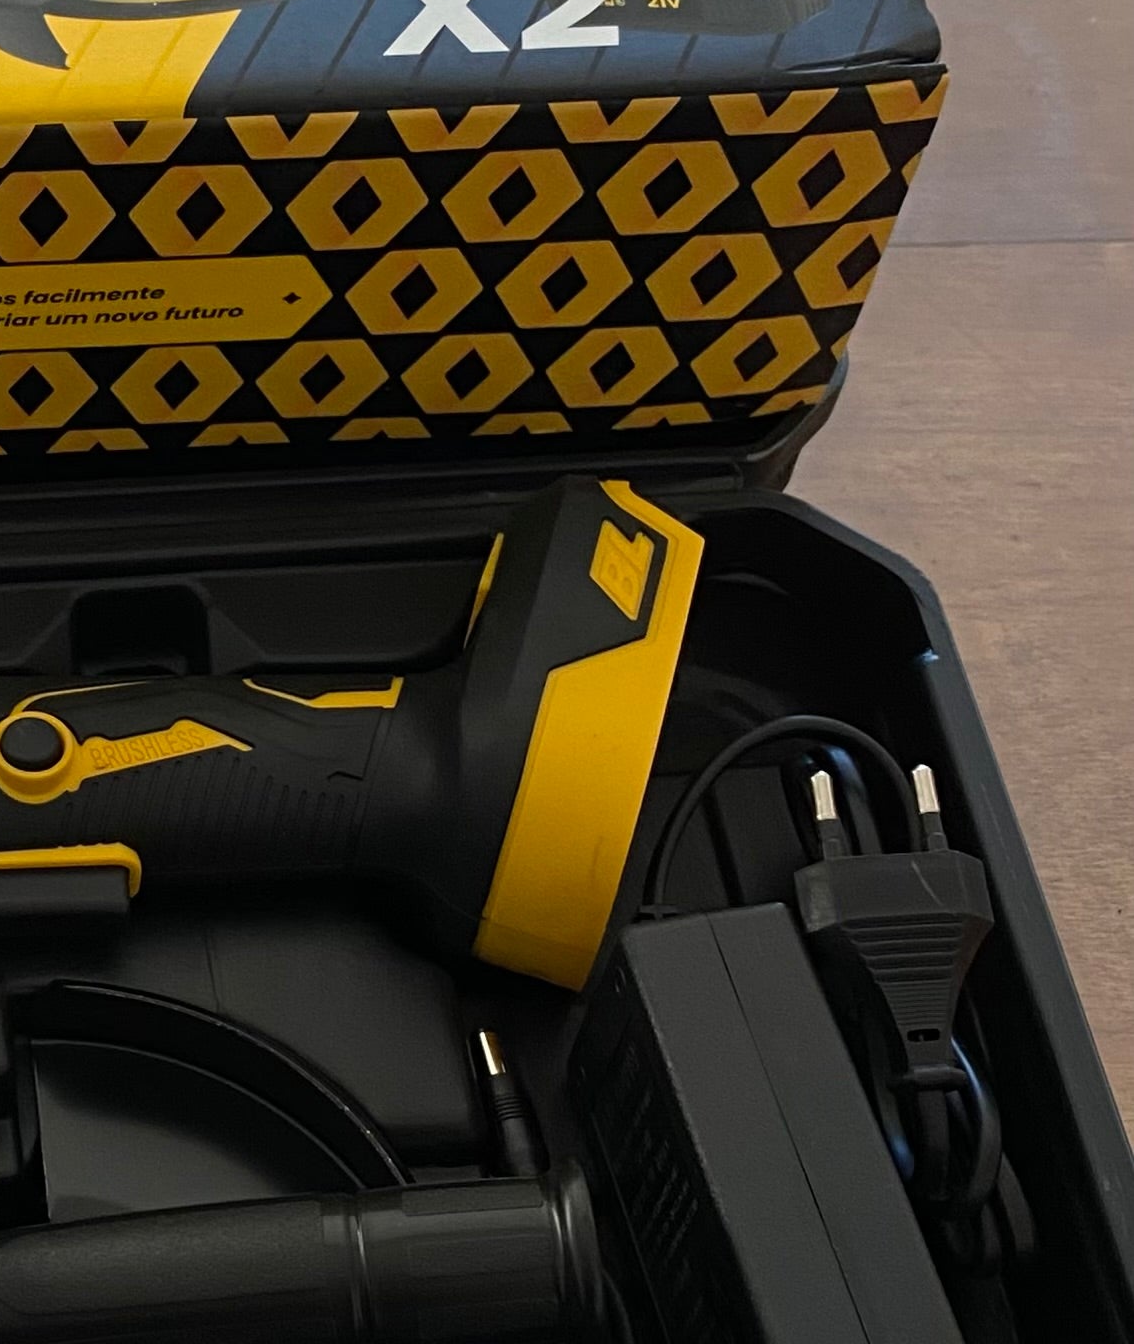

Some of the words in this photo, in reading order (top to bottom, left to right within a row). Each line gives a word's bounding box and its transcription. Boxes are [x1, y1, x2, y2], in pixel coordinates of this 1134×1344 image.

[23, 286, 166, 304] facilmente
[44, 312, 88, 326] um
[93, 309, 159, 324] novo
[164, 305, 245, 321] futuro
[89, 729, 206, 771] BRUSHLESS
